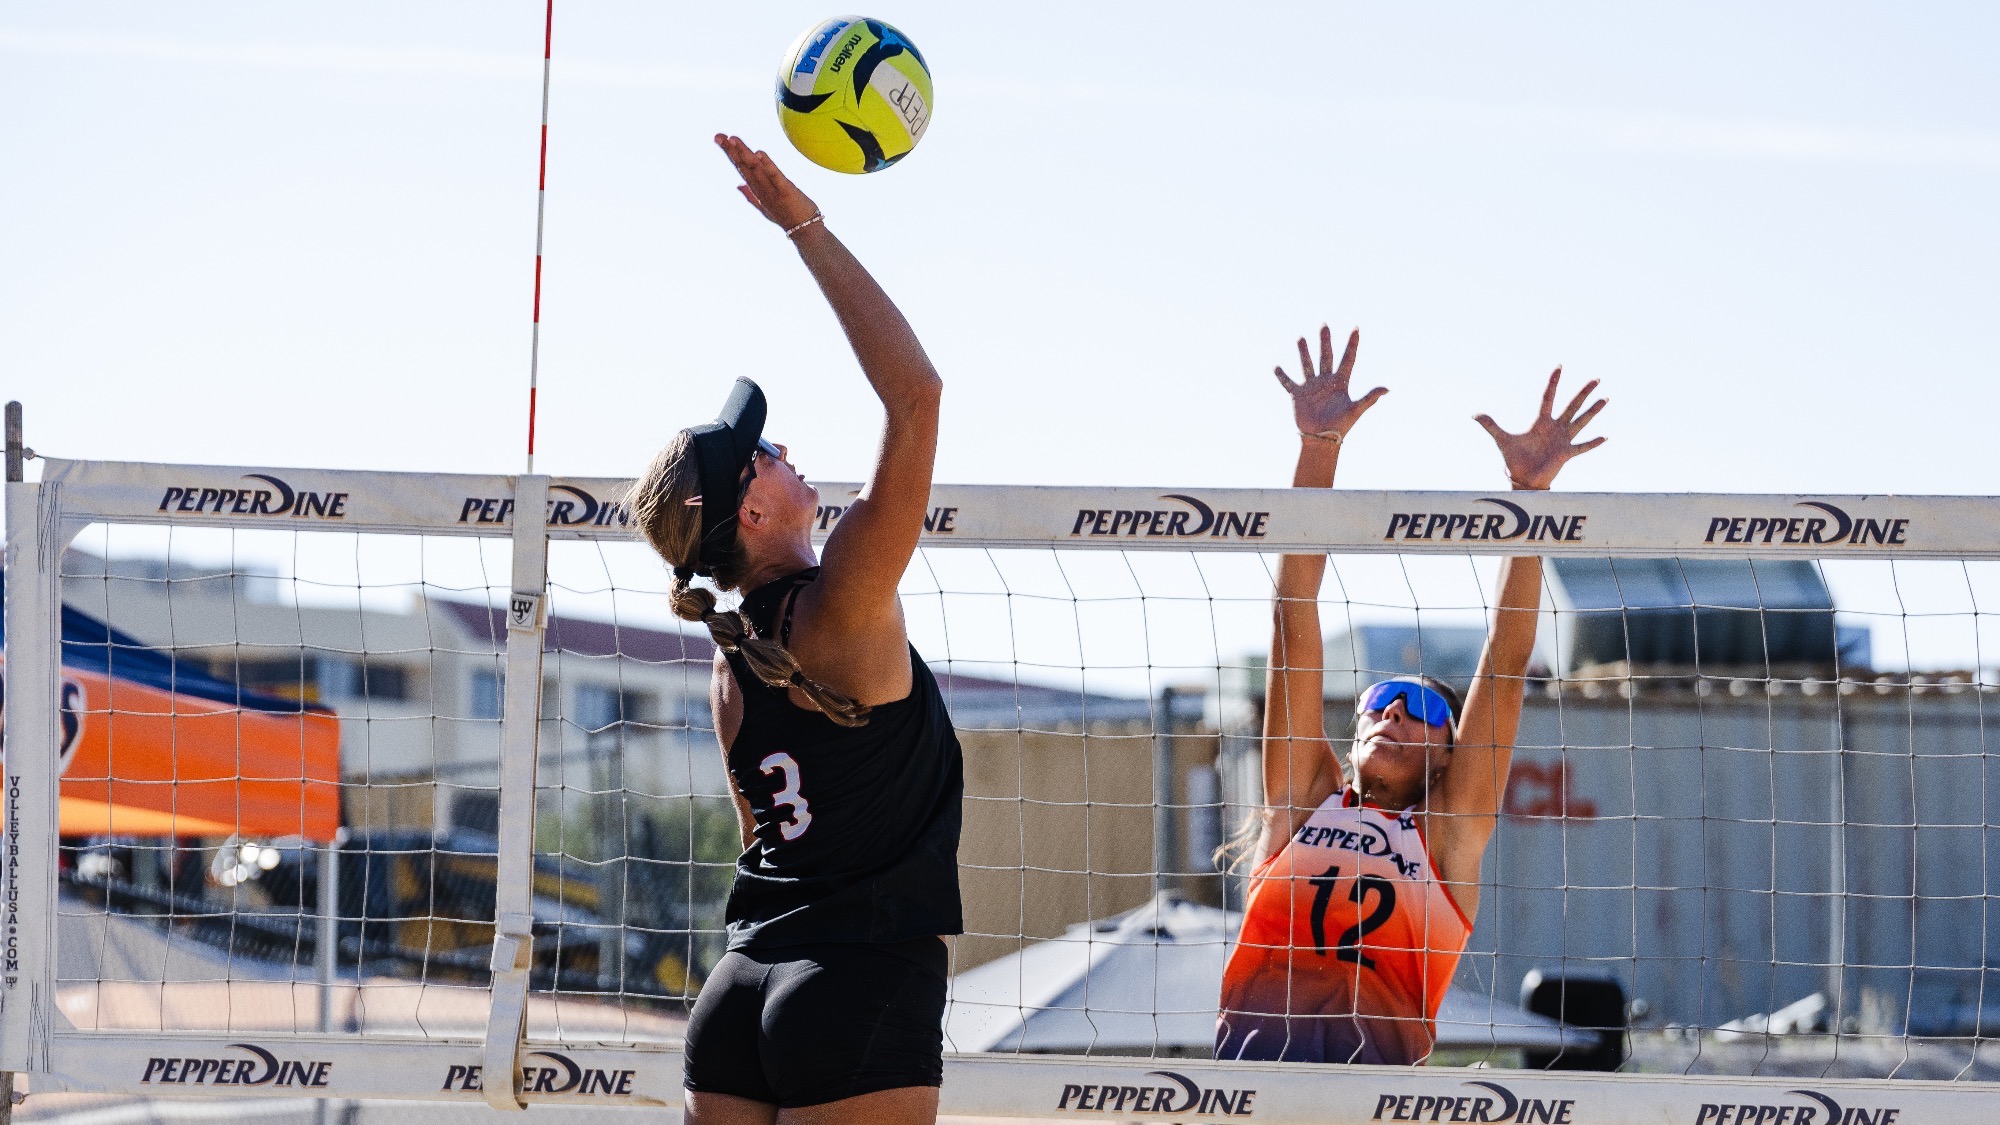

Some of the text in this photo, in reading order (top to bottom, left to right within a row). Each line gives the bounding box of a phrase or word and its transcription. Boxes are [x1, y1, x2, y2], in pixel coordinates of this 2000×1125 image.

[830, 34, 862, 73] molten
[159, 474, 348, 518] PEPPERDINE
[459, 485, 637, 527] PEPRDIN
[1072, 495, 1269, 538] PEPPERDINE
[1386, 499, 1587, 541] PEPPERDINE
[1705, 502, 1910, 545] PEPPERDINE
[760, 752, 812, 842] 3
[1309, 866, 1396, 971] 12
[142, 1044, 332, 1087] PEPPERDINE
[443, 1052, 636, 1095] PEERDINE
[1058, 1071, 1256, 1115] PEPPERDINE
[1374, 1082, 1575, 1125] PEPPERDINE
[1696, 1090, 1900, 1125] PEPPERDINE
